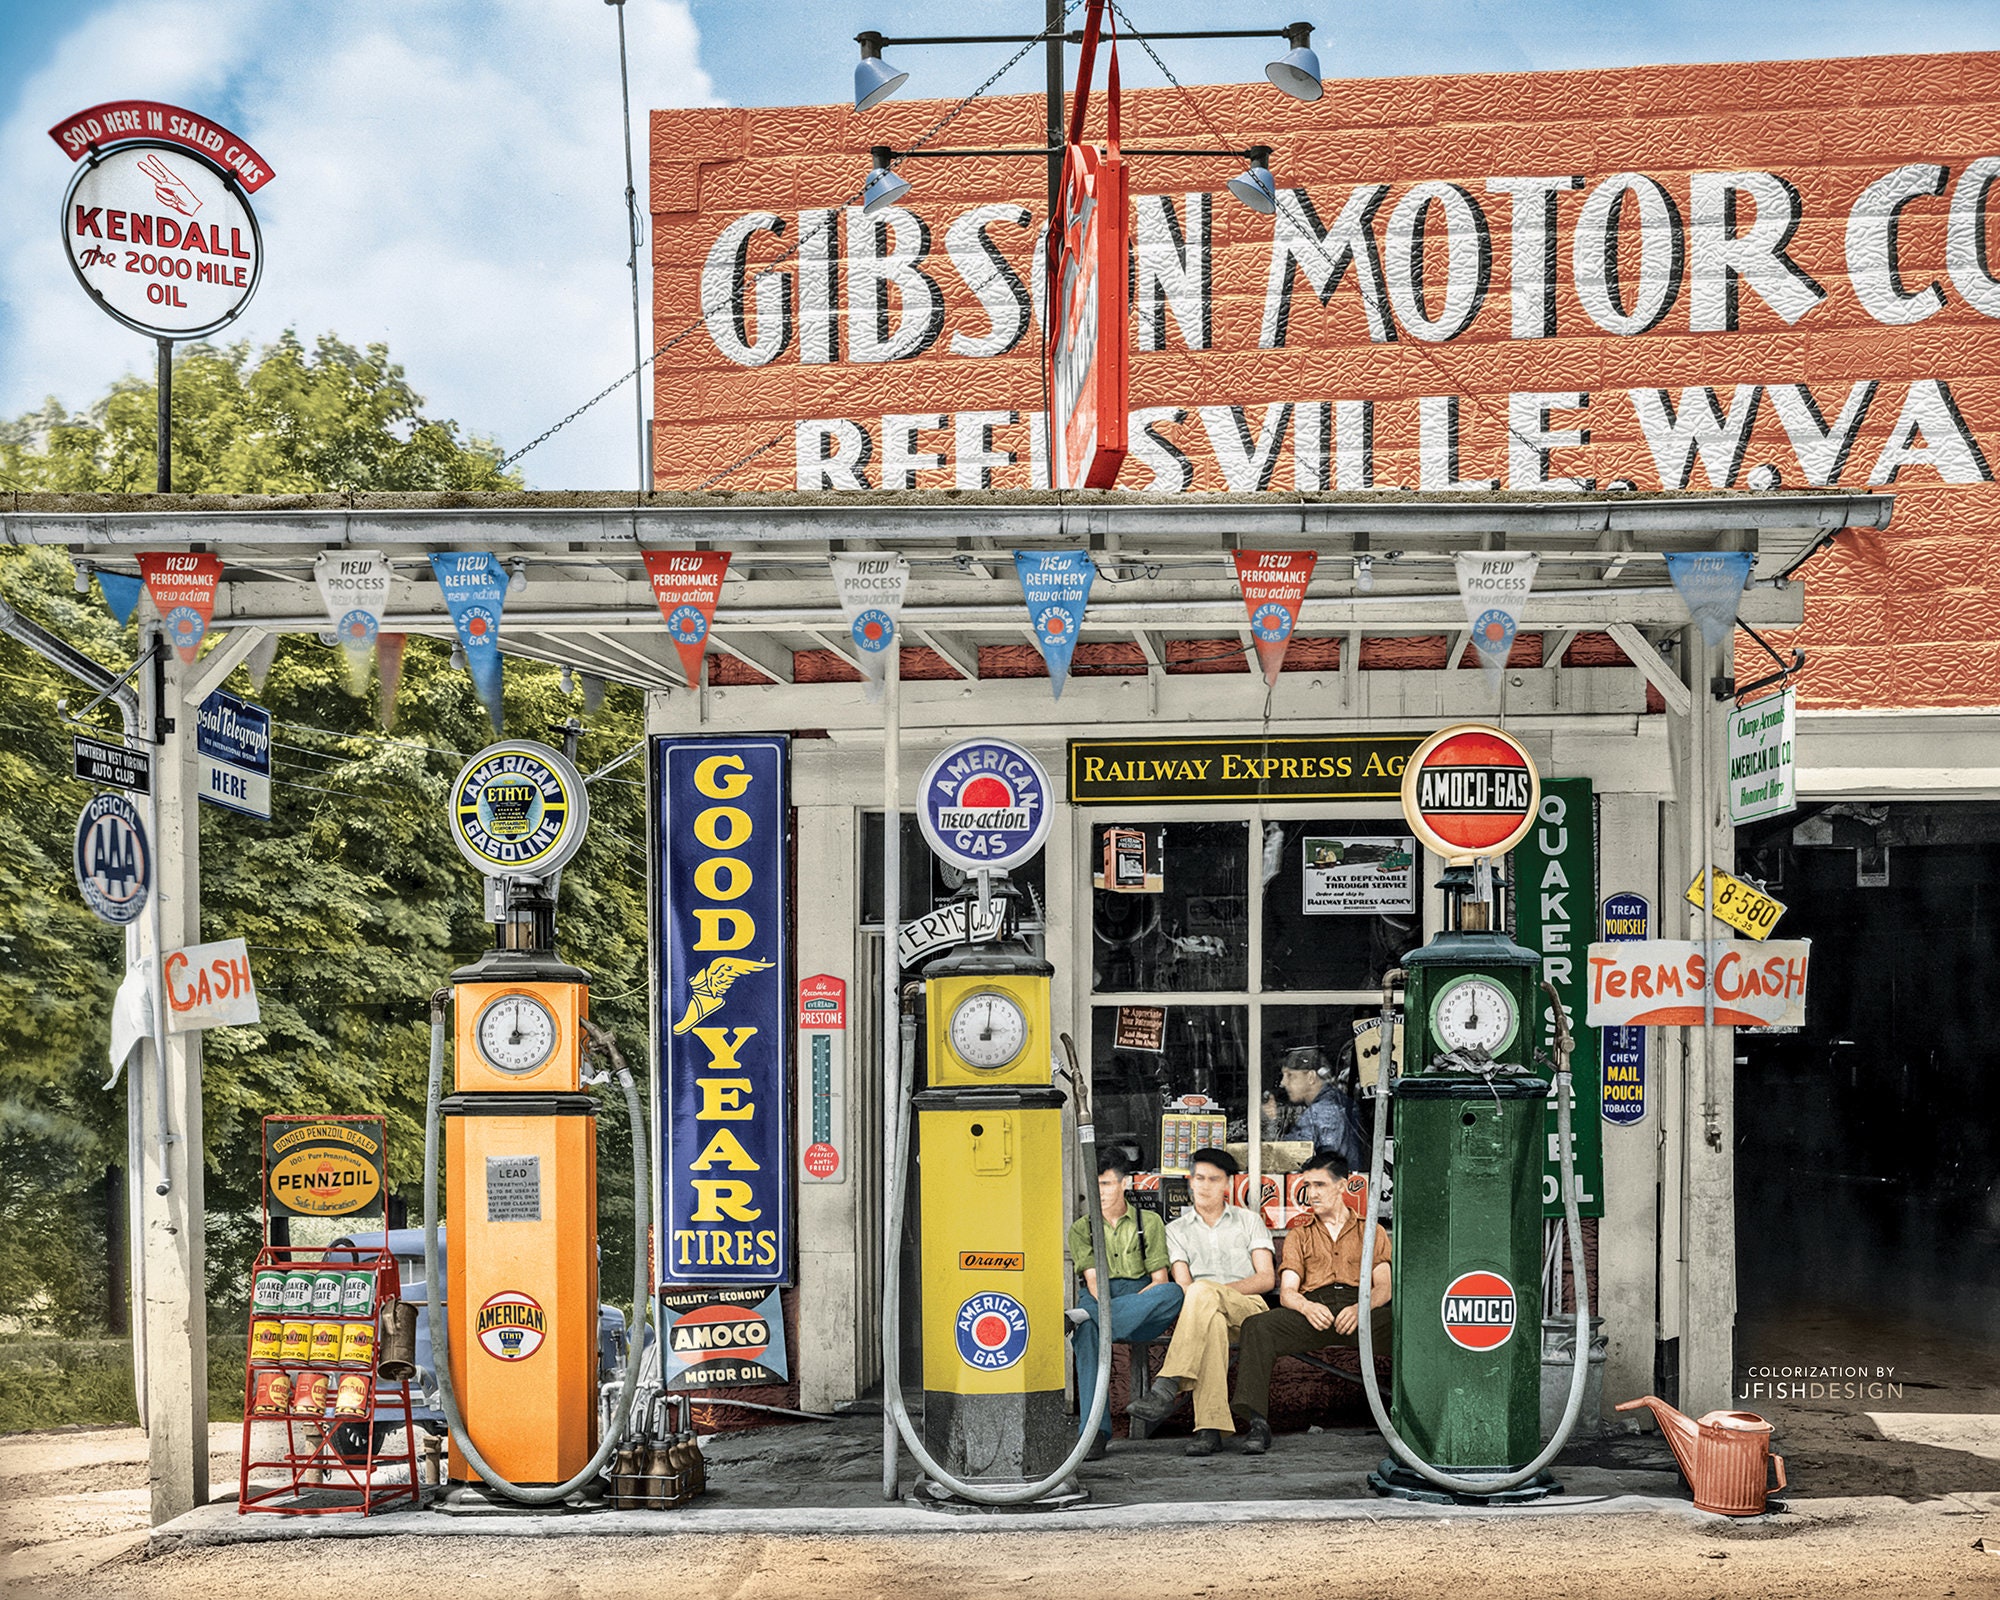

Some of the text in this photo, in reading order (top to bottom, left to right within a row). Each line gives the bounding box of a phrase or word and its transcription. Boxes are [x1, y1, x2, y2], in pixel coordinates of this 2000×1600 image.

[63, 110, 264, 184] SOLD HERE IN SEALED CANS
[76, 205, 251, 259] KENDALL
[80, 245, 247, 288] The 2000 MILE
[1258, 170, 1828, 349] MOTOR
[147, 283, 187, 308] OIL
[166, 557, 198, 571] NEW
[341, 561, 372, 575] NEW
[457, 556, 488, 572] NEW
[670, 557, 702, 571] NEW
[858, 561, 889, 574] NEW
[1040, 556, 1071, 571] NEW
[1259, 555, 1291, 568] NEW
[1482, 561, 1514, 575] NEW
[150, 573, 213, 586] PERFORMANCE
[328, 578, 384, 590] PROCESS
[654, 574, 718, 586] PERFORMANCE
[845, 577, 901, 589] PROCESS
[1026, 573, 1086, 585] REFINERY
[1241, 570, 1306, 583] PERFORMANCE
[1468, 578, 1525, 590] PROCESS
[156, 588, 210, 602] new action
[660, 588, 714, 602] new action
[1028, 587, 1082, 601] new action
[1246, 585, 1301, 599] new action
[168, 608, 201, 632] AMERICAN
[342, 612, 376, 635] AMERICAN
[459, 608, 495, 632] AMERICAN
[671, 608, 704, 632] AMERICAN
[855, 612, 891, 634] AMERICAN
[1037, 607, 1074, 633] AMERICAN
[1253, 605, 1290, 629] AMERICAN
[1477, 612, 1513, 635] AMERICAN
[176, 635, 192, 644] GAS
[469, 635, 490, 645] GAS
[679, 634, 697, 642] GAS
[863, 638, 880, 649] GAS
[1044, 636, 1067, 644] GAS
[1262, 631, 1280, 640] GAS
[197, 706, 267, 754] ostal Telegraph
[1738, 705, 1785, 739] Charge Accounts
[77, 743, 147, 772] NORTHERN WEST VIRGINIA
[1731, 749, 1767, 780] AMERICAN
[1769, 745, 1779, 770] OIL
[92, 762, 134, 784] AUTO CLUB
[1084, 756, 1212, 782] RAILWAY
[1221, 754, 1352, 780] EXPRESS
[212, 768, 247, 800] HERE
[465, 757, 561, 799] AMERICAN
[936, 750, 1039, 809] AMERICAN
[488, 787, 532, 802] ETHYL
[1421, 772, 1528, 807] AMOCO-GAS
[1741, 779, 1784, 807] Honored Here
[90, 797, 137, 831] OFFICIAL
[465, 818, 561, 861] GASOLINE
[955, 830, 1007, 855] GAS
[94, 818, 138, 897] AAA
[1538, 795, 1572, 985] QUAKER
[1611, 905, 1642, 916] TREAT
[1606, 919, 1646, 935] YOURSELF
[164, 951, 250, 1012] CASH
[801, 1012, 842, 1024] PRESTONE
[1610, 1054, 1638, 1062] CHEW
[1608, 1066, 1640, 1081] MAIL
[1604, 1085, 1642, 1100] POUCH
[1604, 1104, 1641, 1112] TOBACCO
[276, 1127, 375, 1151] BONDED PENNZOIL DEALER
[324, 1152, 361, 1166] Pennsylvania
[279, 1170, 372, 1190] PENNZOIL
[500, 1169, 526, 1178] LEAD
[1542, 1174, 1594, 1204] OL
[293, 1196, 357, 1211] Safe Lubrication
[674, 1230, 777, 1266] TIRES
[965, 1255, 1019, 1268] Orange
[259, 1291, 279, 1300] STATE
[666, 1290, 765, 1306] QUALITY ECONOMY
[478, 1305, 542, 1332] AMERICAN
[959, 1297, 1025, 1332] AMERICAN
[1446, 1299, 1513, 1323] AMOCO
[674, 1322, 766, 1350] AMOCO
[973, 1350, 1008, 1366] GAS
[685, 1366, 766, 1383] MOTOR OIL
